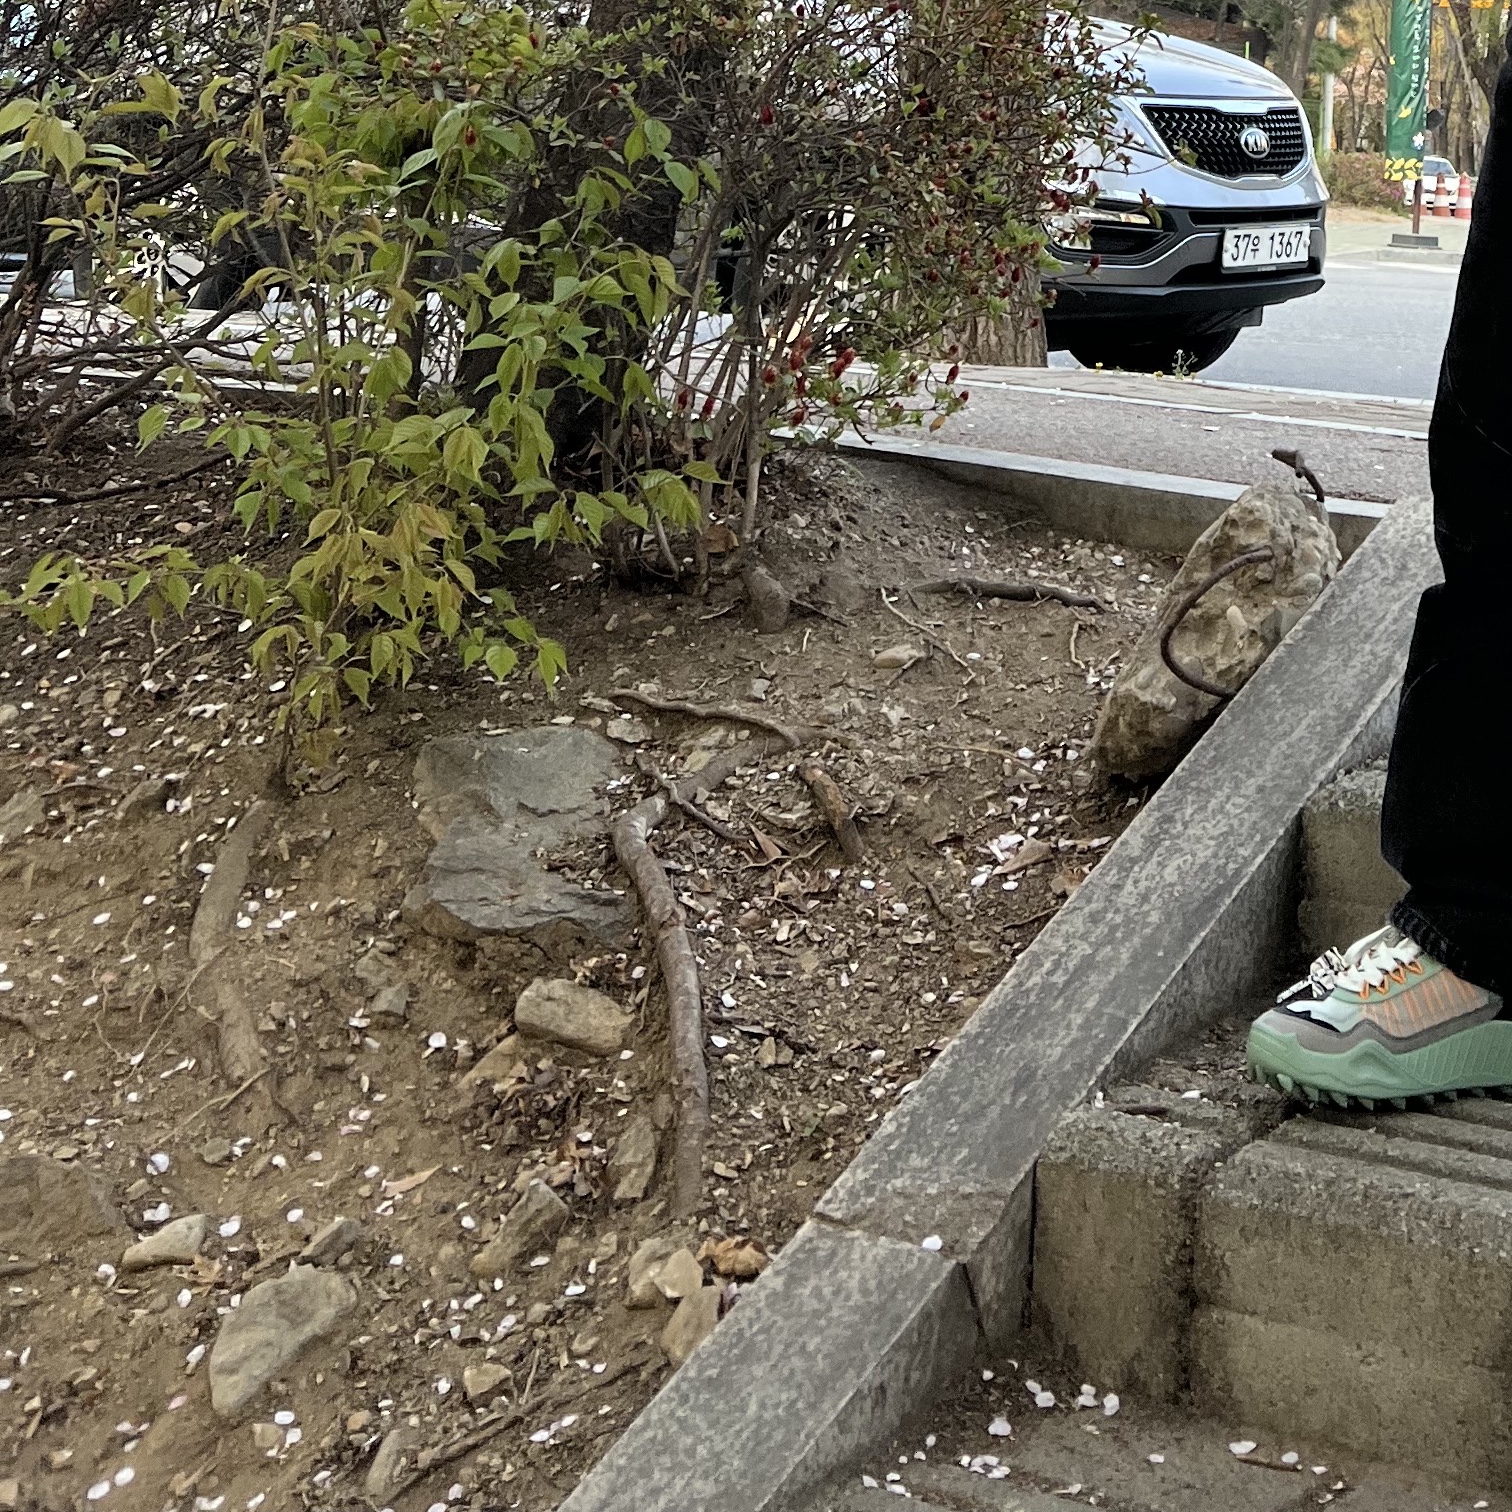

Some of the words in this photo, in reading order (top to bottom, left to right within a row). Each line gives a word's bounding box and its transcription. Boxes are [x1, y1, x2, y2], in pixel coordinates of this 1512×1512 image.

[1246, 133, 1269, 152] KIA
[1231, 233, 1261, 262] 37우
[1268, 229, 1304, 259] 1367
